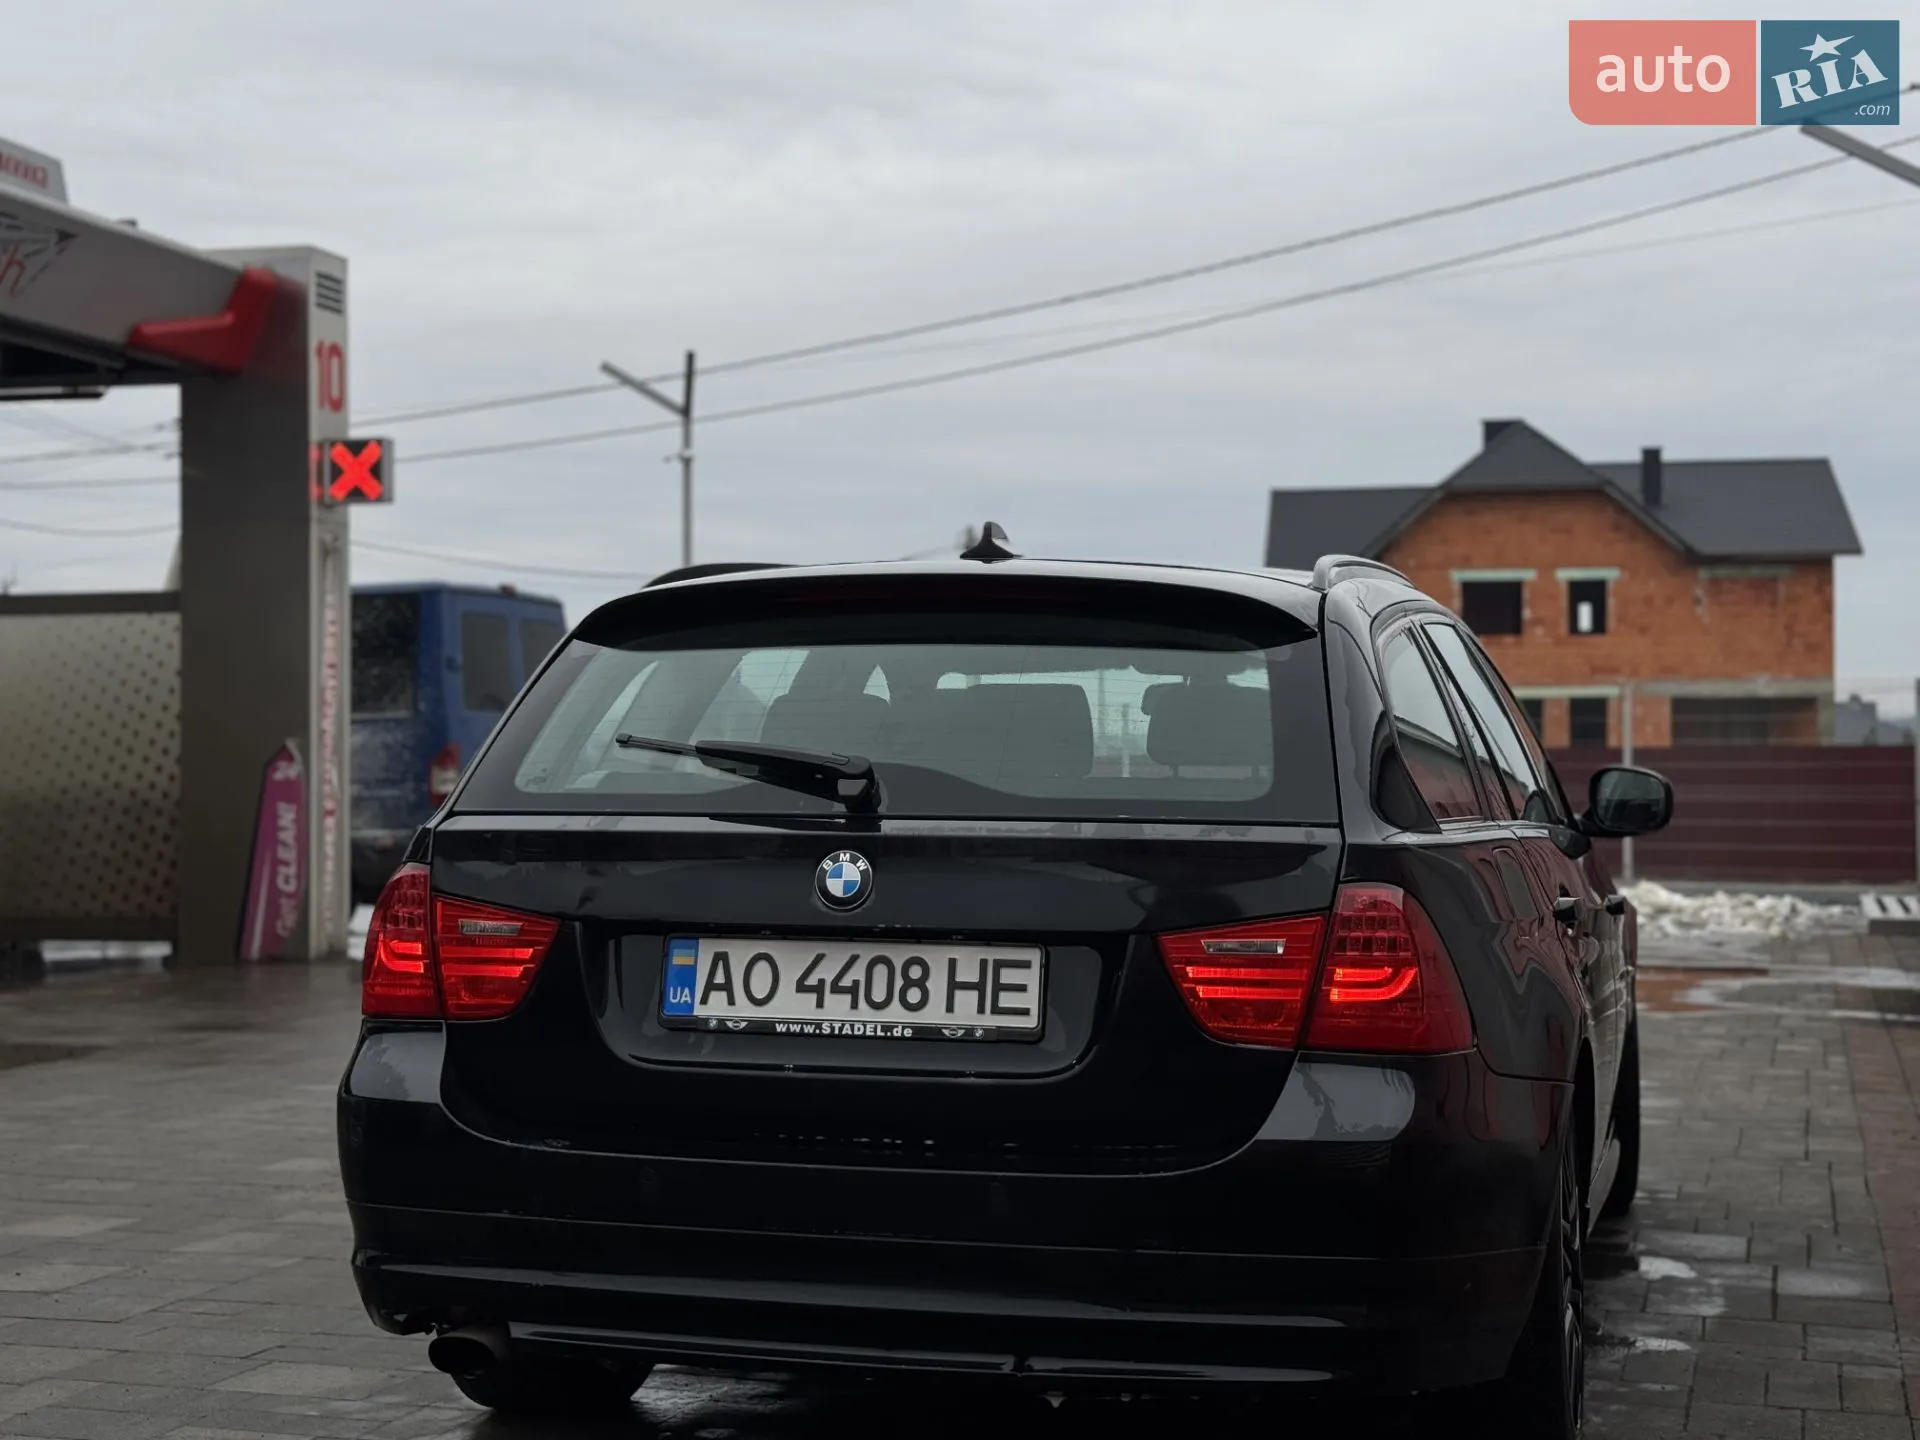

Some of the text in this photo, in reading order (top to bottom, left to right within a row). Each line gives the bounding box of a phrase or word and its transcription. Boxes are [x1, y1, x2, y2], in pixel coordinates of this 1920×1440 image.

[314, 340, 345, 413] 10
[822, 852, 868, 871] BMW
[699, 950, 1033, 1016] AO 4408 HE
[669, 986, 692, 1004] UA
[775, 1021, 914, 1038] www.STADEL.de
